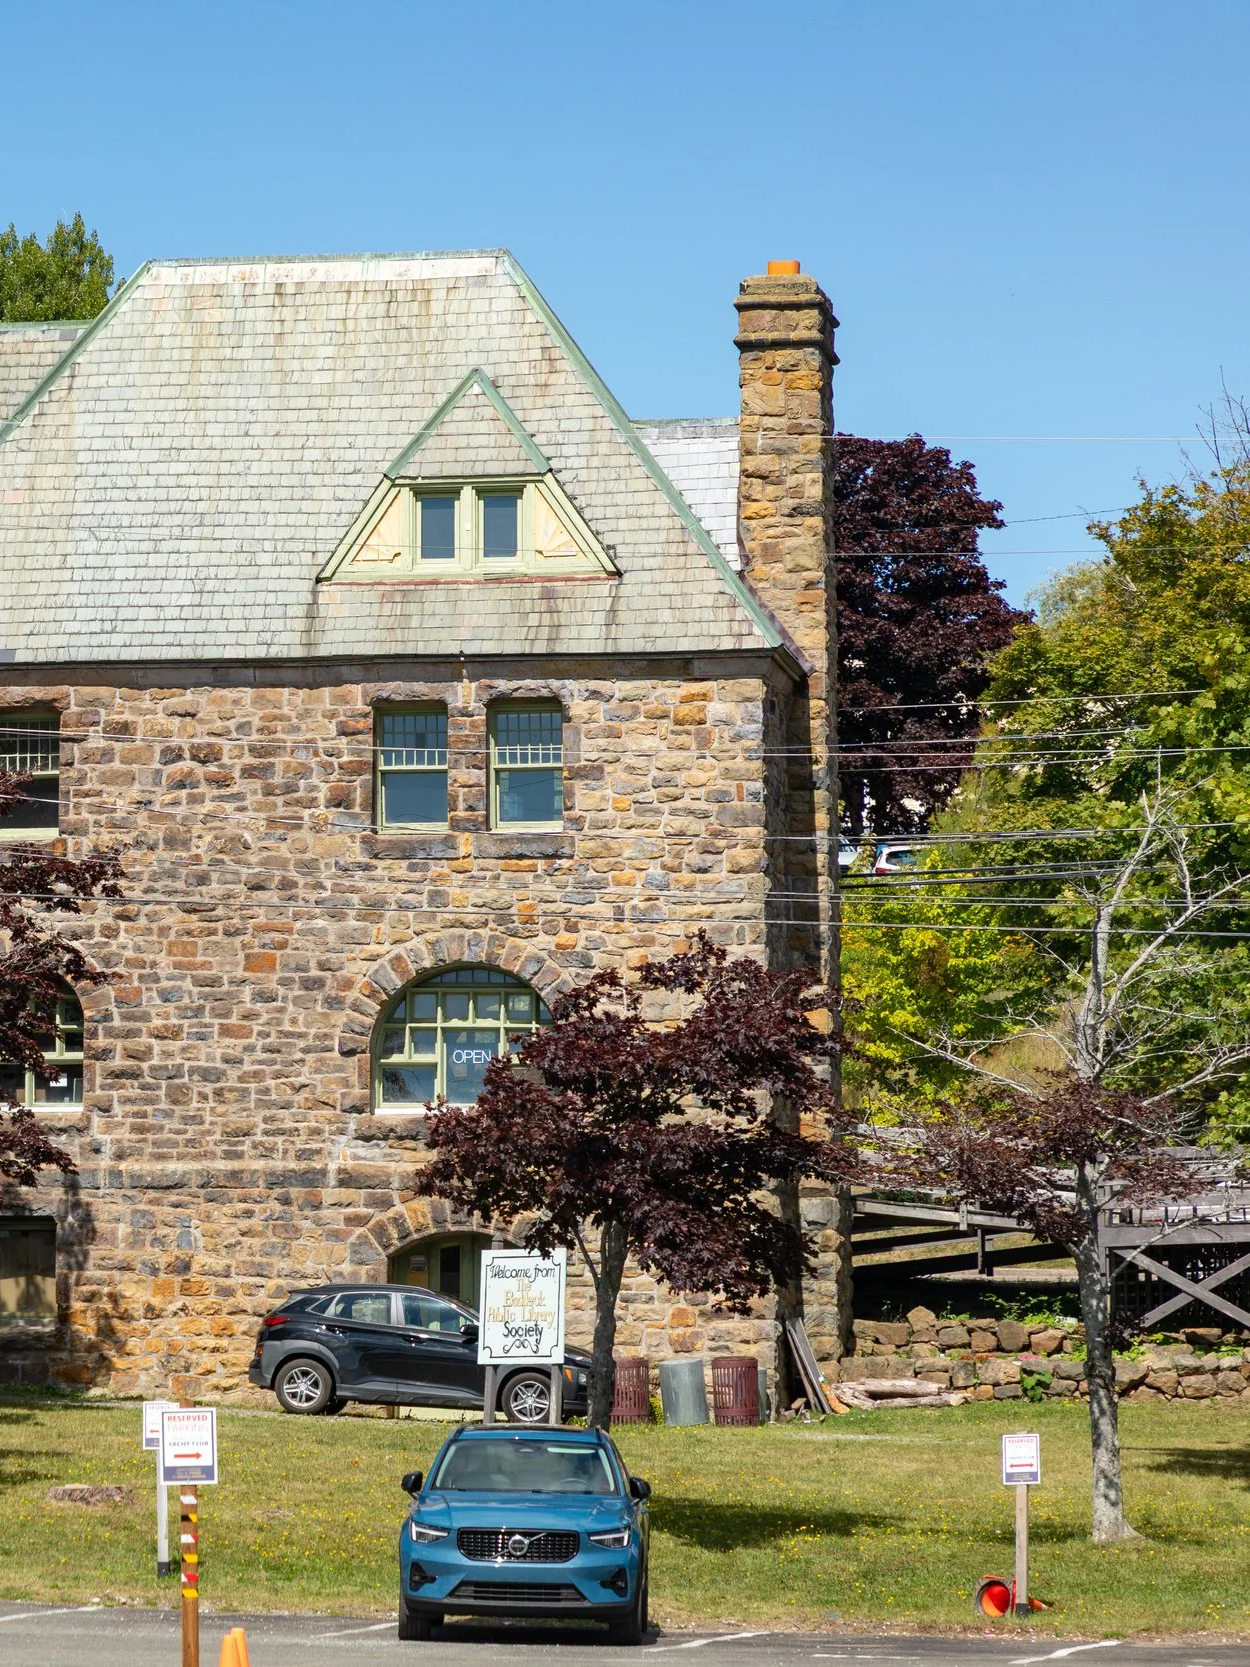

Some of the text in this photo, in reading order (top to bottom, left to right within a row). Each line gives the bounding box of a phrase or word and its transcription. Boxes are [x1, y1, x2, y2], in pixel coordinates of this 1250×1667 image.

[452, 1049, 492, 1064] OPEN
[490, 1263, 556, 1283] Welcome from
[516, 1279, 532, 1292] The
[487, 1306, 556, 1329] Public Library
[502, 1320, 544, 1345] Society
[167, 1414, 208, 1422] RESERVED
[167, 1422, 209, 1433] PARKING
